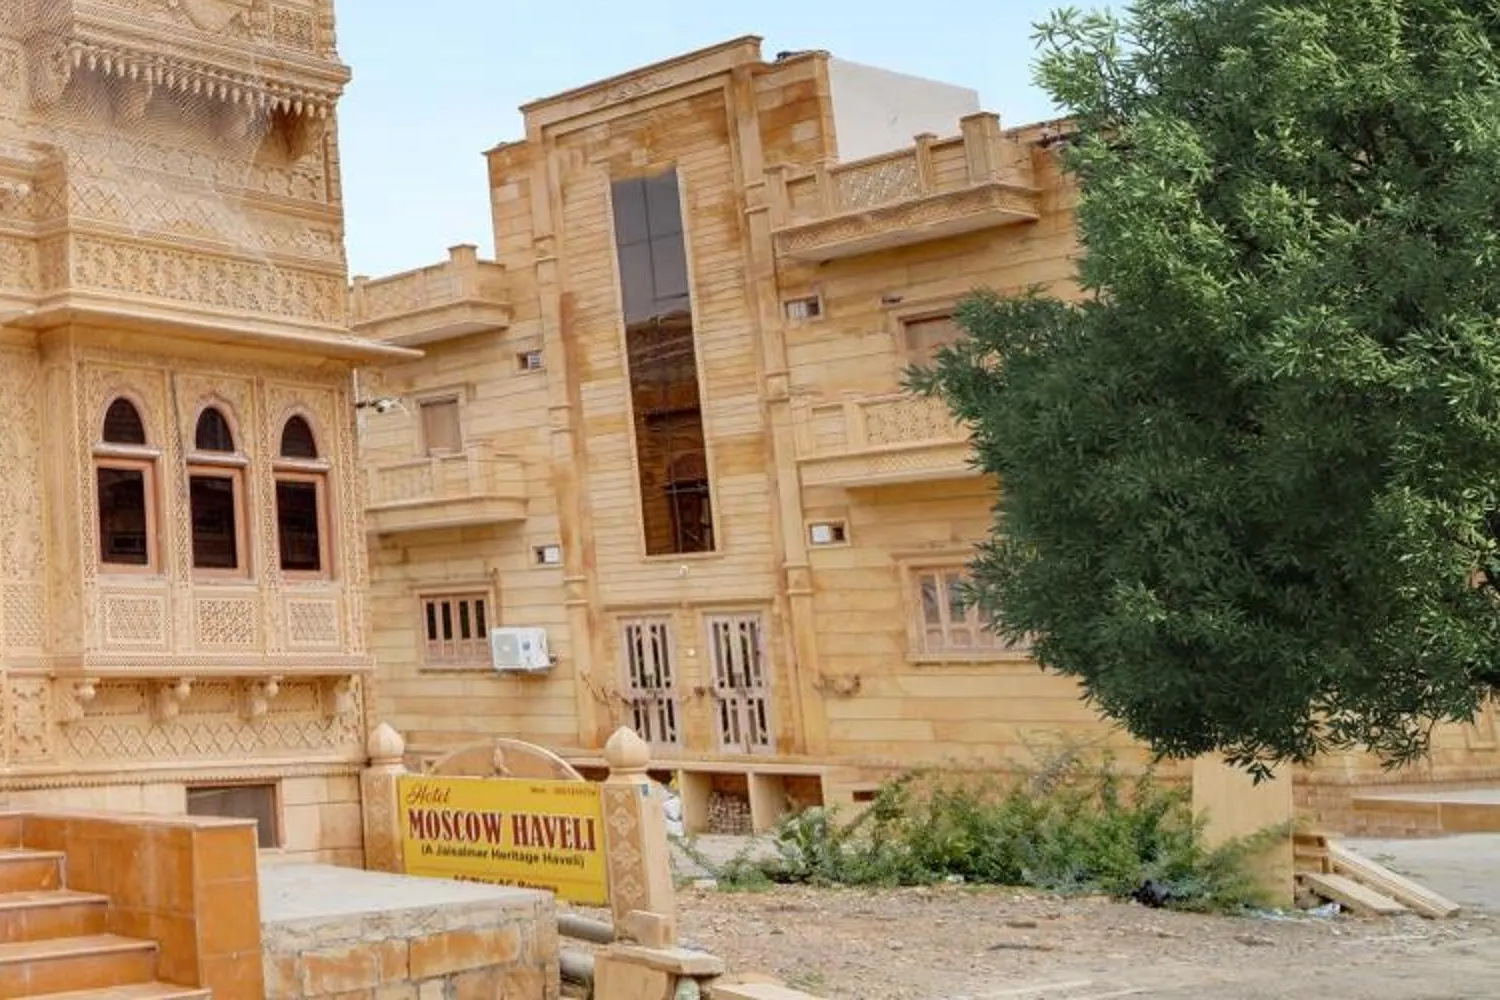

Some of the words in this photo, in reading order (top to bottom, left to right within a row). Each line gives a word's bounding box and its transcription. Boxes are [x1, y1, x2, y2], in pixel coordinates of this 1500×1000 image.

[407, 783, 450, 805] Hotel
[408, 808, 501, 844] MOSCOW
[512, 814, 596, 850] HAVELI
[421, 843, 432, 856] (A
[436, 844, 489, 859] Jaisalmer
[491, 848, 539, 865] Heritage
[543, 852, 585, 869] Haveli)
